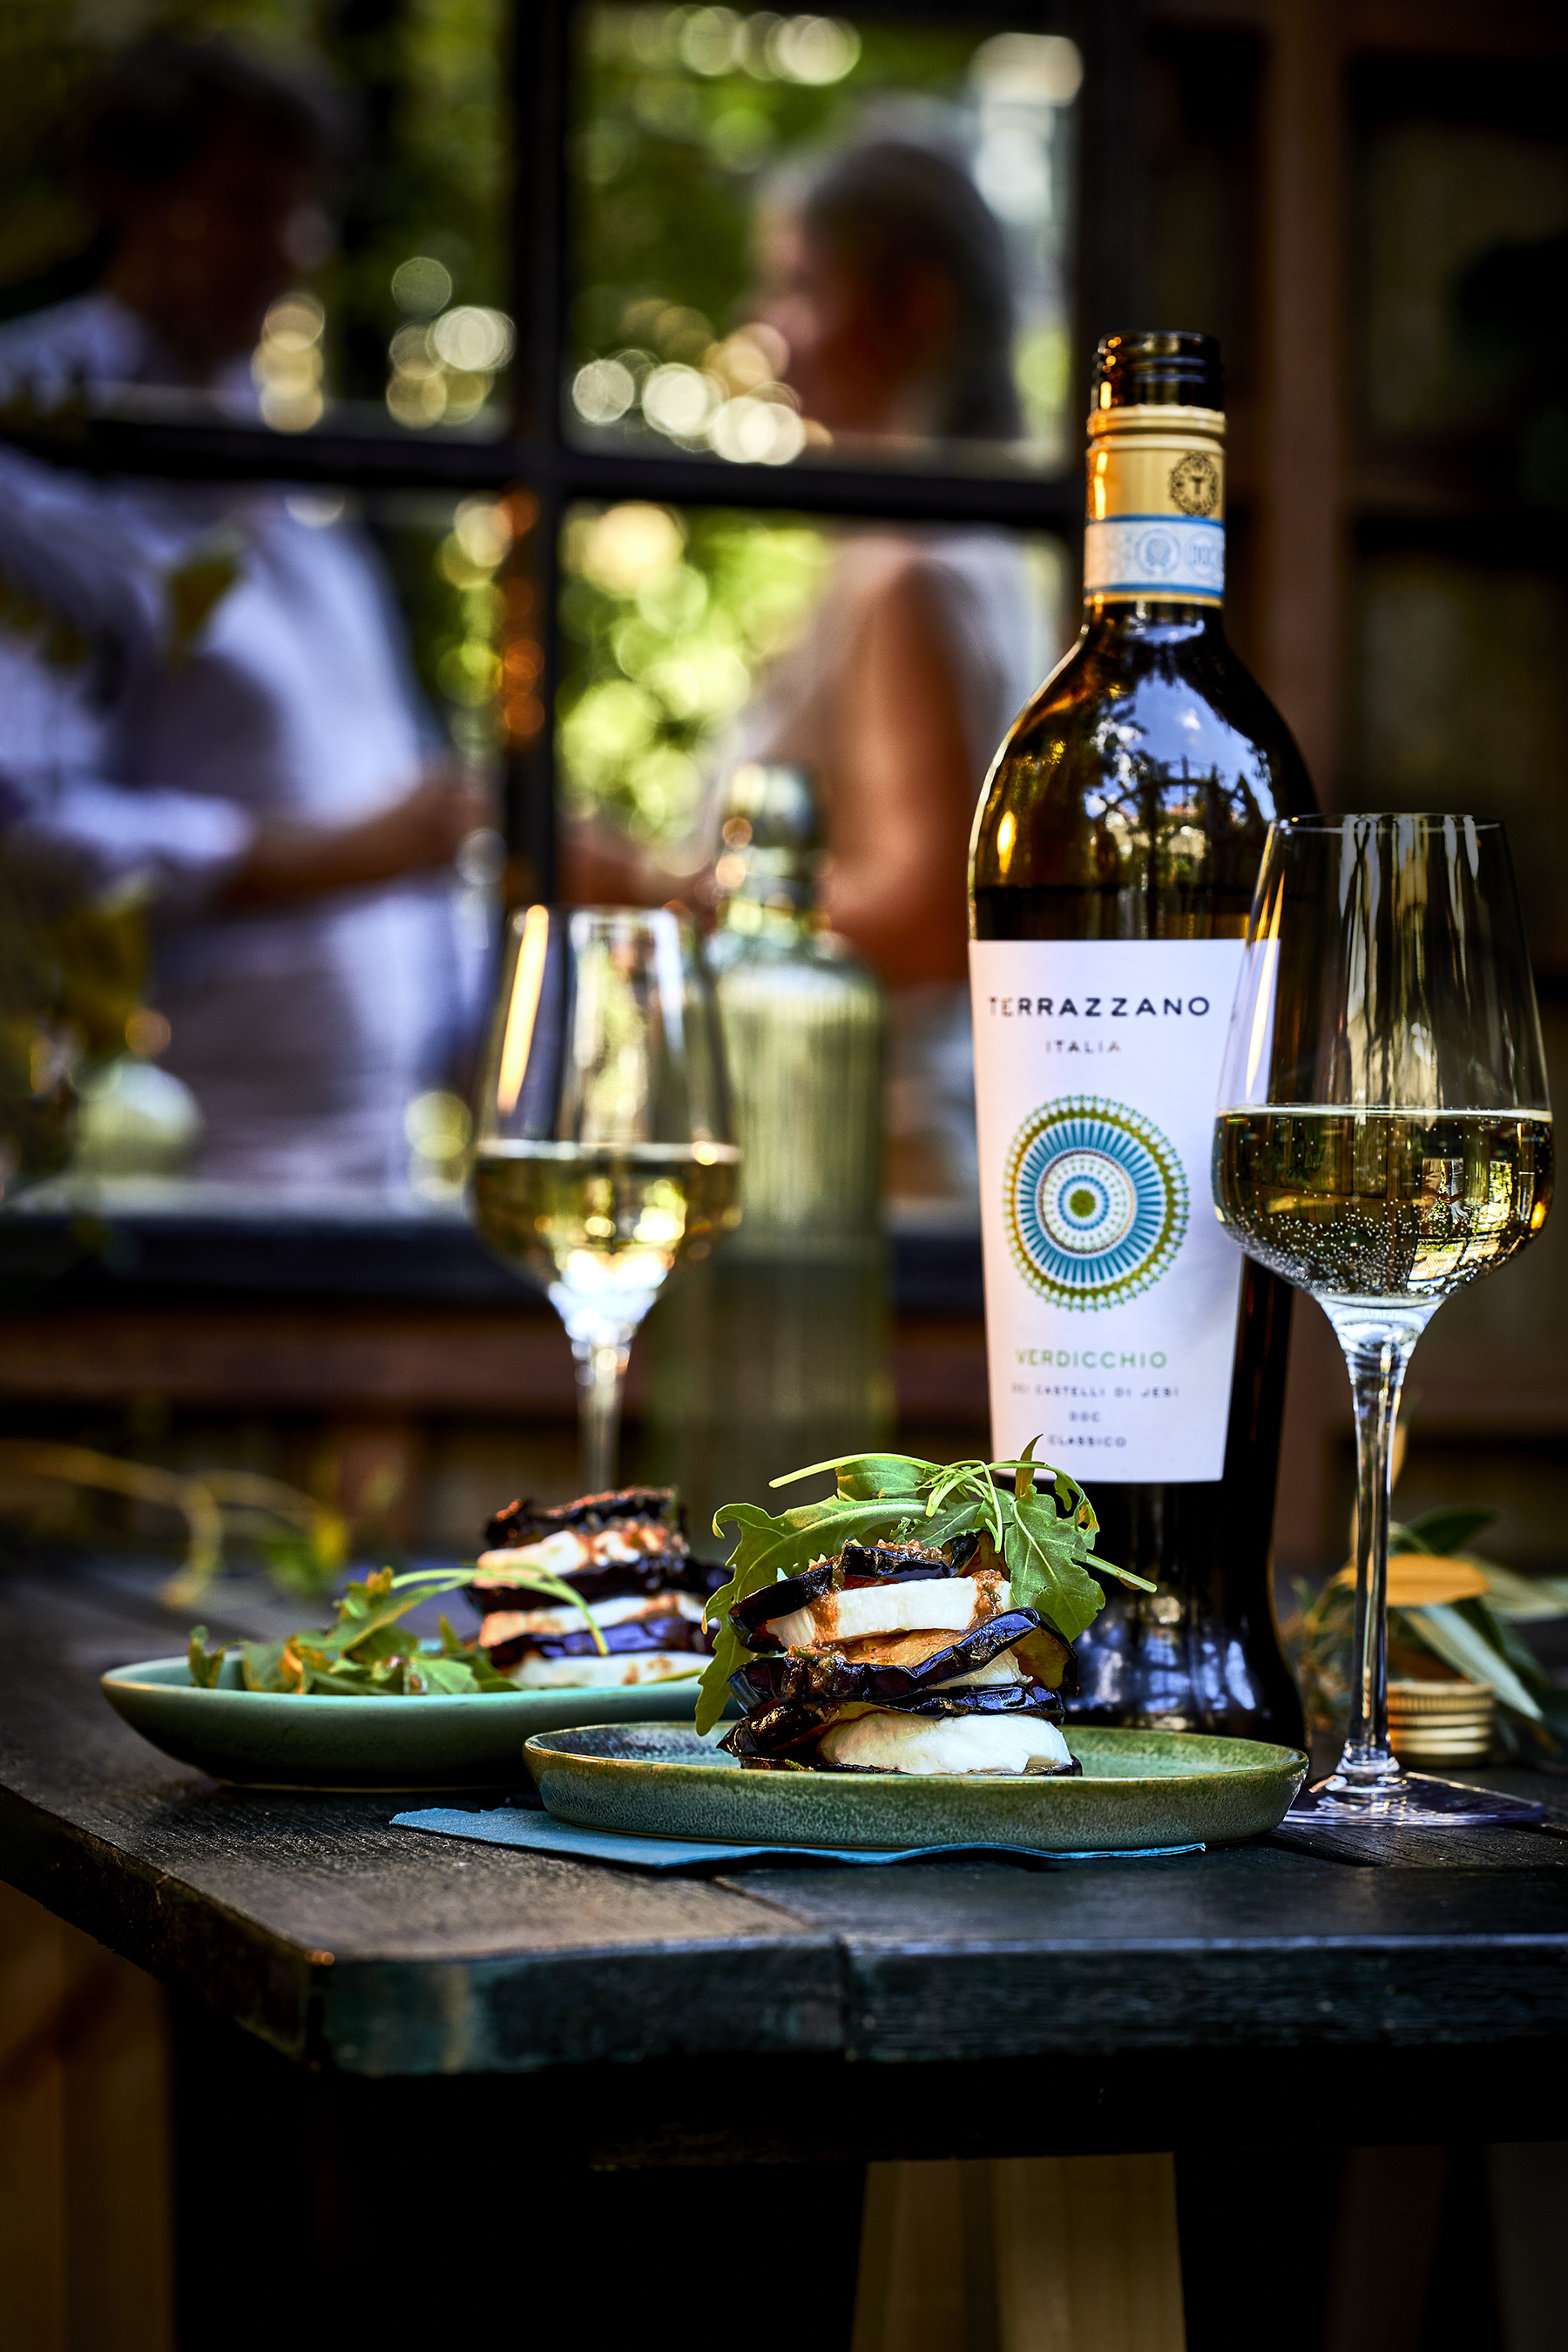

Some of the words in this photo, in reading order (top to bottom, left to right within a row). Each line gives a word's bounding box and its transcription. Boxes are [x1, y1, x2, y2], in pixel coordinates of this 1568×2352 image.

[989, 996, 1211, 1017] TERRAZZANO
[1045, 1039, 1121, 1054] ITALIA
[1015, 1349, 1168, 1369] VERDICCHIO
[1035, 1384, 1105, 1398] CASTELLI
[1114, 1387, 1132, 1398] DI
[1139, 1387, 1179, 1399] JESI
[1047, 1434, 1128, 1448] CLASSICO
